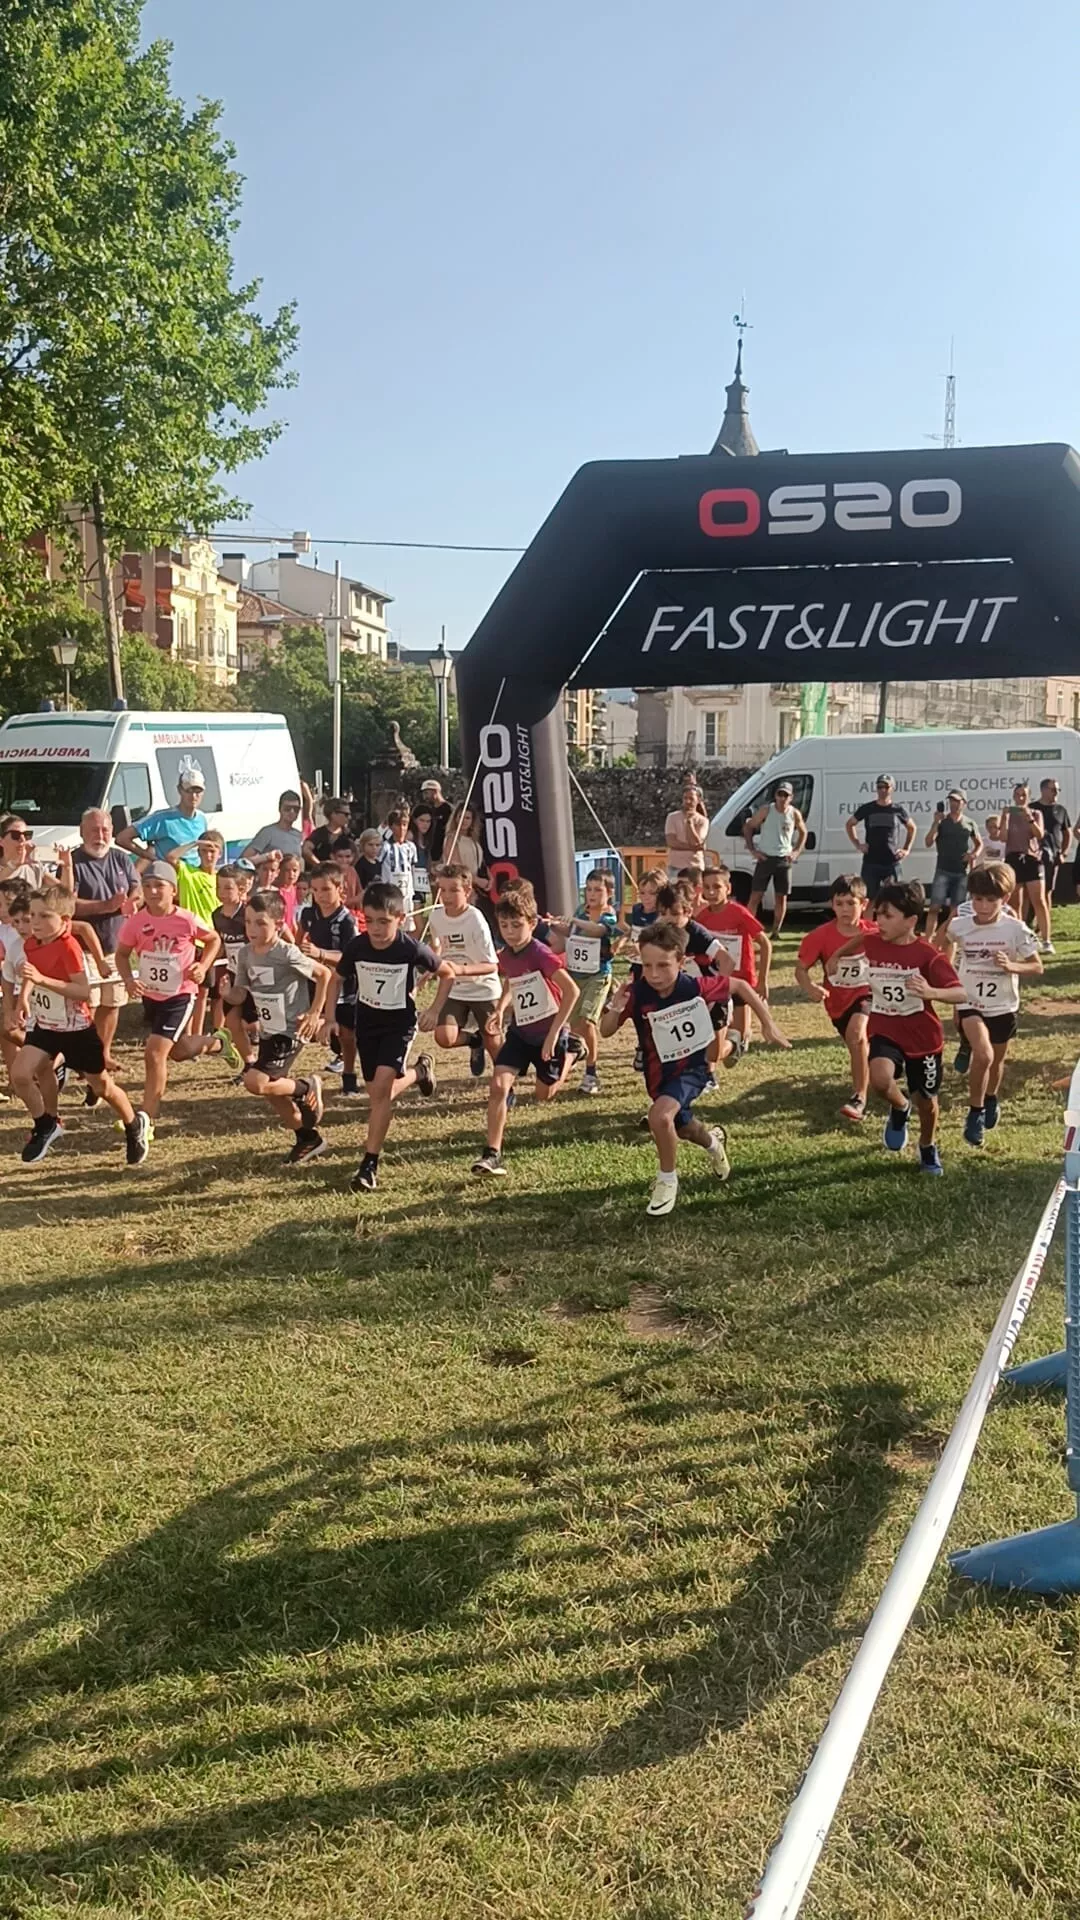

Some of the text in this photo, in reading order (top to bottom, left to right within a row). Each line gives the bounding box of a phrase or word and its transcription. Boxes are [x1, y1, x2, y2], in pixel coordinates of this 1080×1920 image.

[642, 596, 1018, 651] FAST&LIGHT
[153, 733, 204, 744] AMBULANCIA
[516, 723, 534, 812] FAST&LIGHT
[935, 779, 953, 791] DE
[960, 777, 1017, 790] COCHES
[574, 948, 588, 962] 95
[150, 967, 168, 982] 38
[841, 966, 860, 978] 75
[375, 980, 386, 994] 7
[882, 986, 905, 1002] 53
[976, 982, 997, 998] 12
[517, 991, 539, 1010] 22
[670, 1021, 696, 1042] 19
